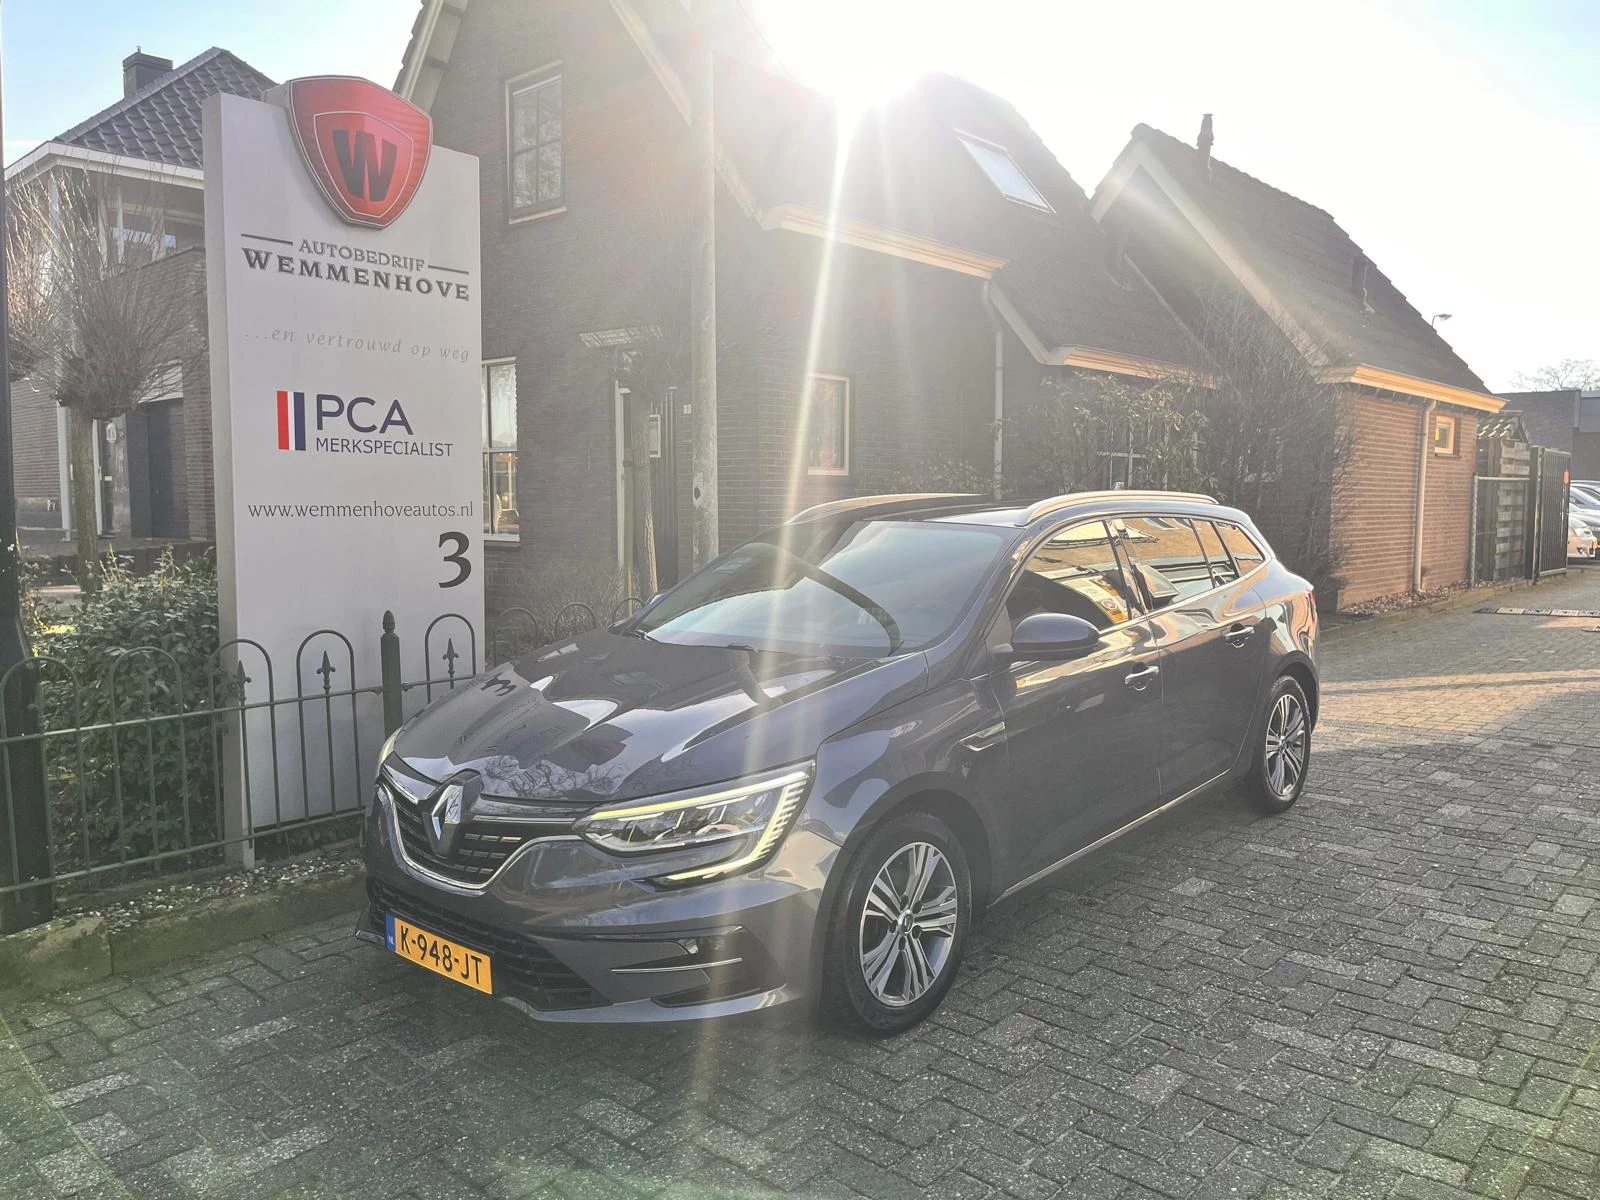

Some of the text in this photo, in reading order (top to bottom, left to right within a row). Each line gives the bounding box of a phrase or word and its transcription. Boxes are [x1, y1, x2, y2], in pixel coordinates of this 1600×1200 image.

[332, 129, 397, 202] W
[241, 248, 470, 300] WEMMENHOVE
[299, 239, 425, 272] AUTOBEDRIJF
[306, 332, 402, 353] vertrouwd
[411, 344, 431, 359] op
[440, 346, 469, 363] weg
[316, 394, 414, 435] PCA
[316, 438, 453, 457] MERKSPECIALIST
[248, 500, 473, 518] www.wemmenhoveautos.nl
[438, 531, 472, 588] 3
[400, 925, 482, 985] K-948-JT
